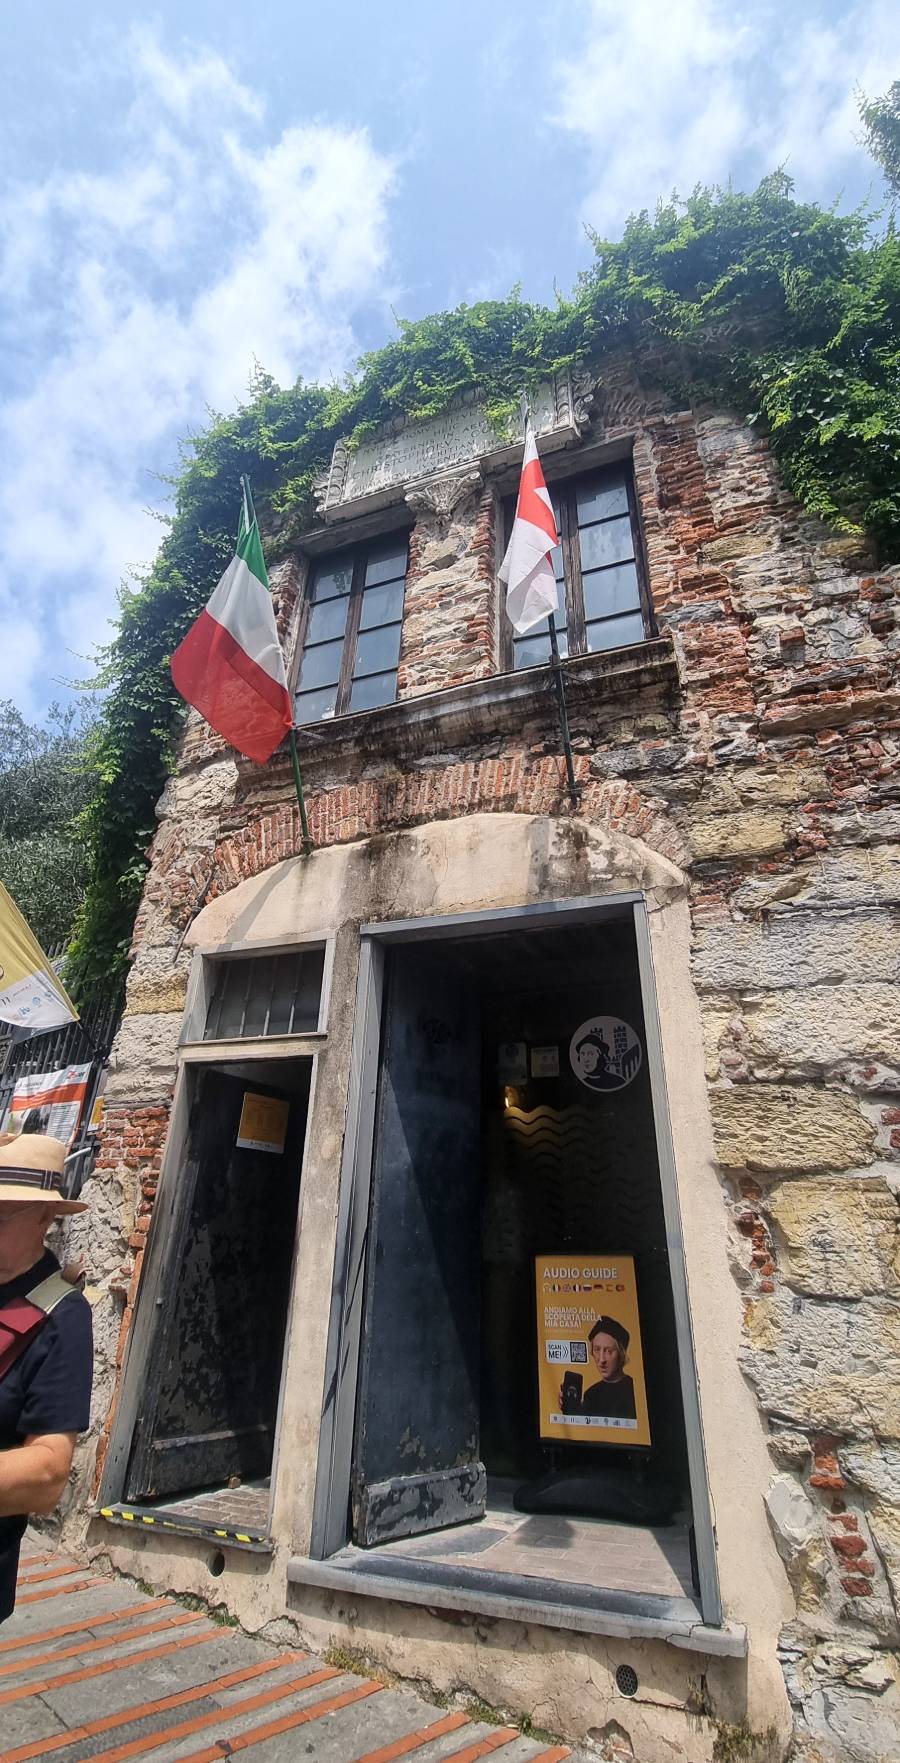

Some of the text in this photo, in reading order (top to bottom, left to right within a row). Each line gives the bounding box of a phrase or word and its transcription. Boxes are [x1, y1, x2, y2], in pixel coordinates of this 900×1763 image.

[543, 1267, 618, 1279] AUDIO GUIDE
[544, 1306, 577, 1314] ANDIAMO
[544, 1313, 602, 1322] SCOPERTA DELLA
[544, 1320, 582, 1329] MIA CASA!
[548, 1350, 562, 1359] ME!
